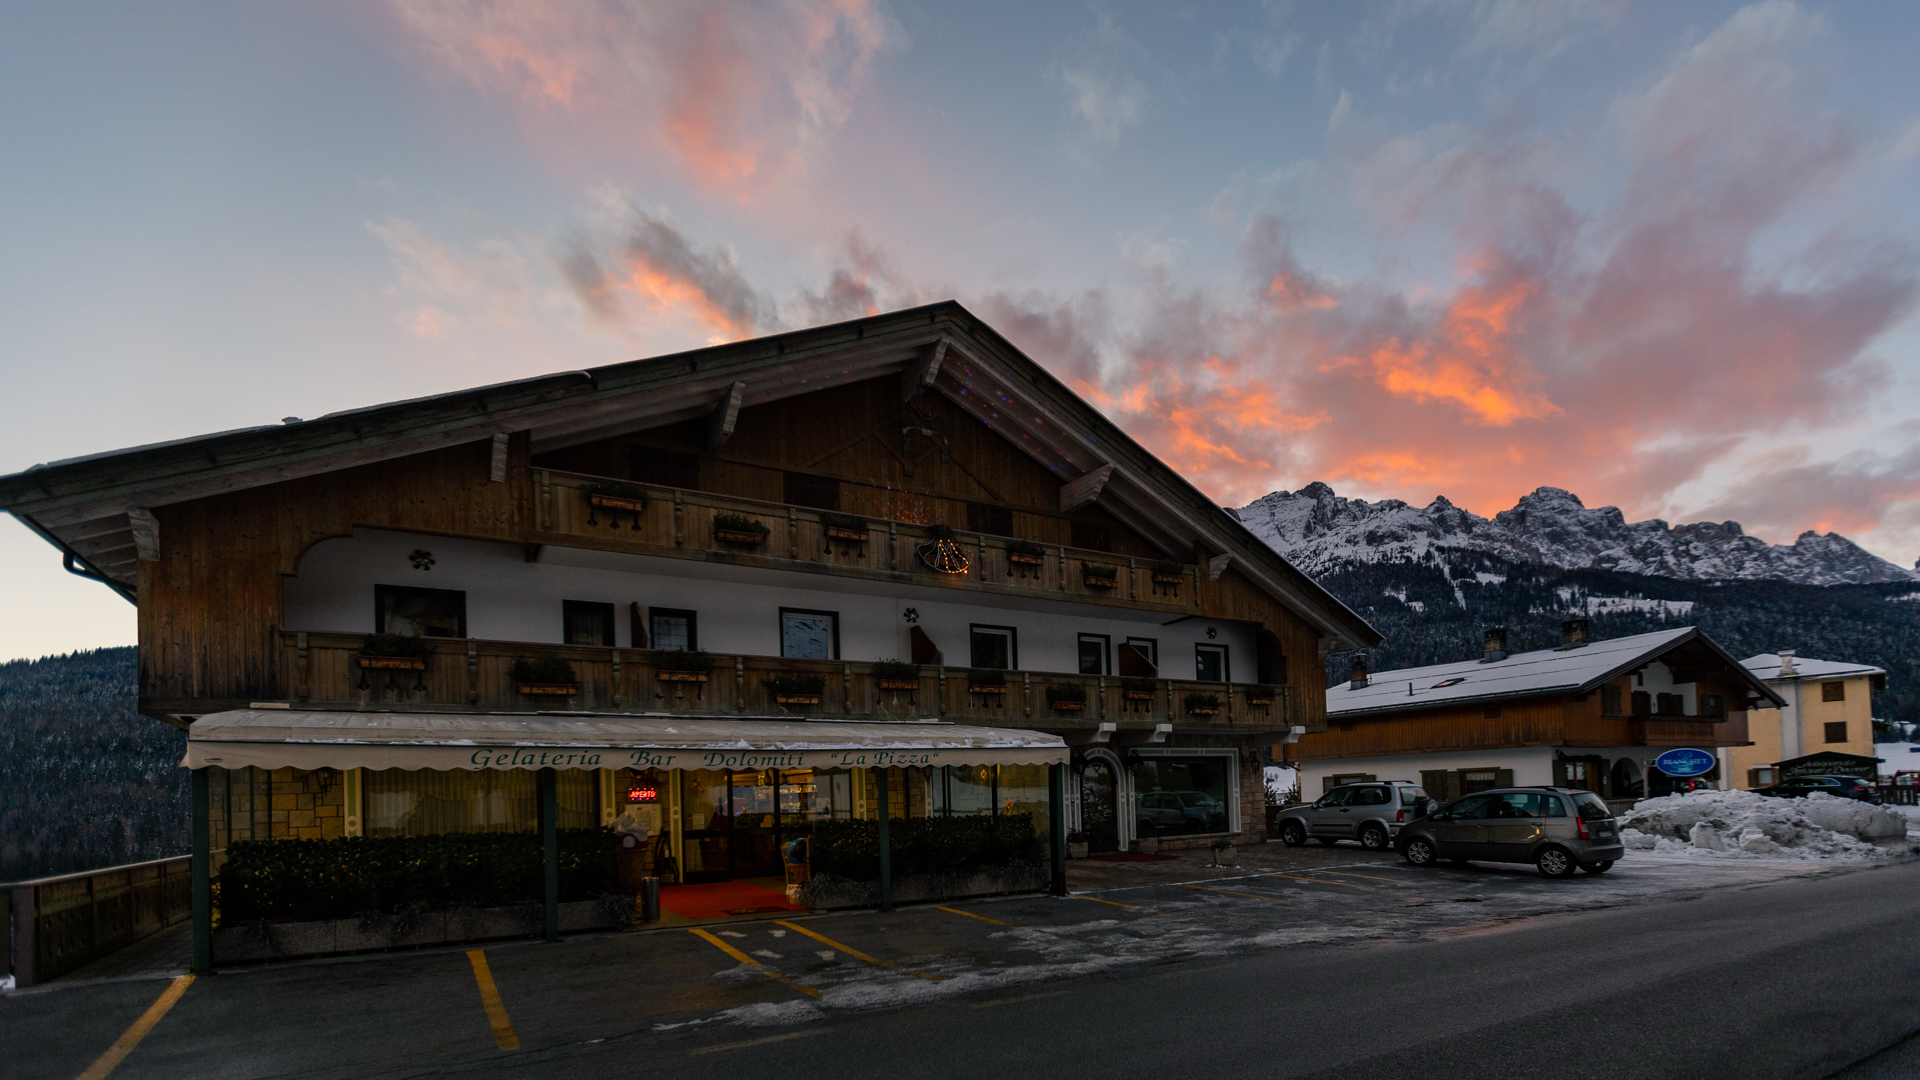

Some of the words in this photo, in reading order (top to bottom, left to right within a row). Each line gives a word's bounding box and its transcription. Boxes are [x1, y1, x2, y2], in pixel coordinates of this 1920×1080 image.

[471, 747, 602, 770] Gelateria
[630, 750, 676, 766] Bar
[703, 751, 805, 767] Dolomiti
[630, 790, 657, 798] APERTO
